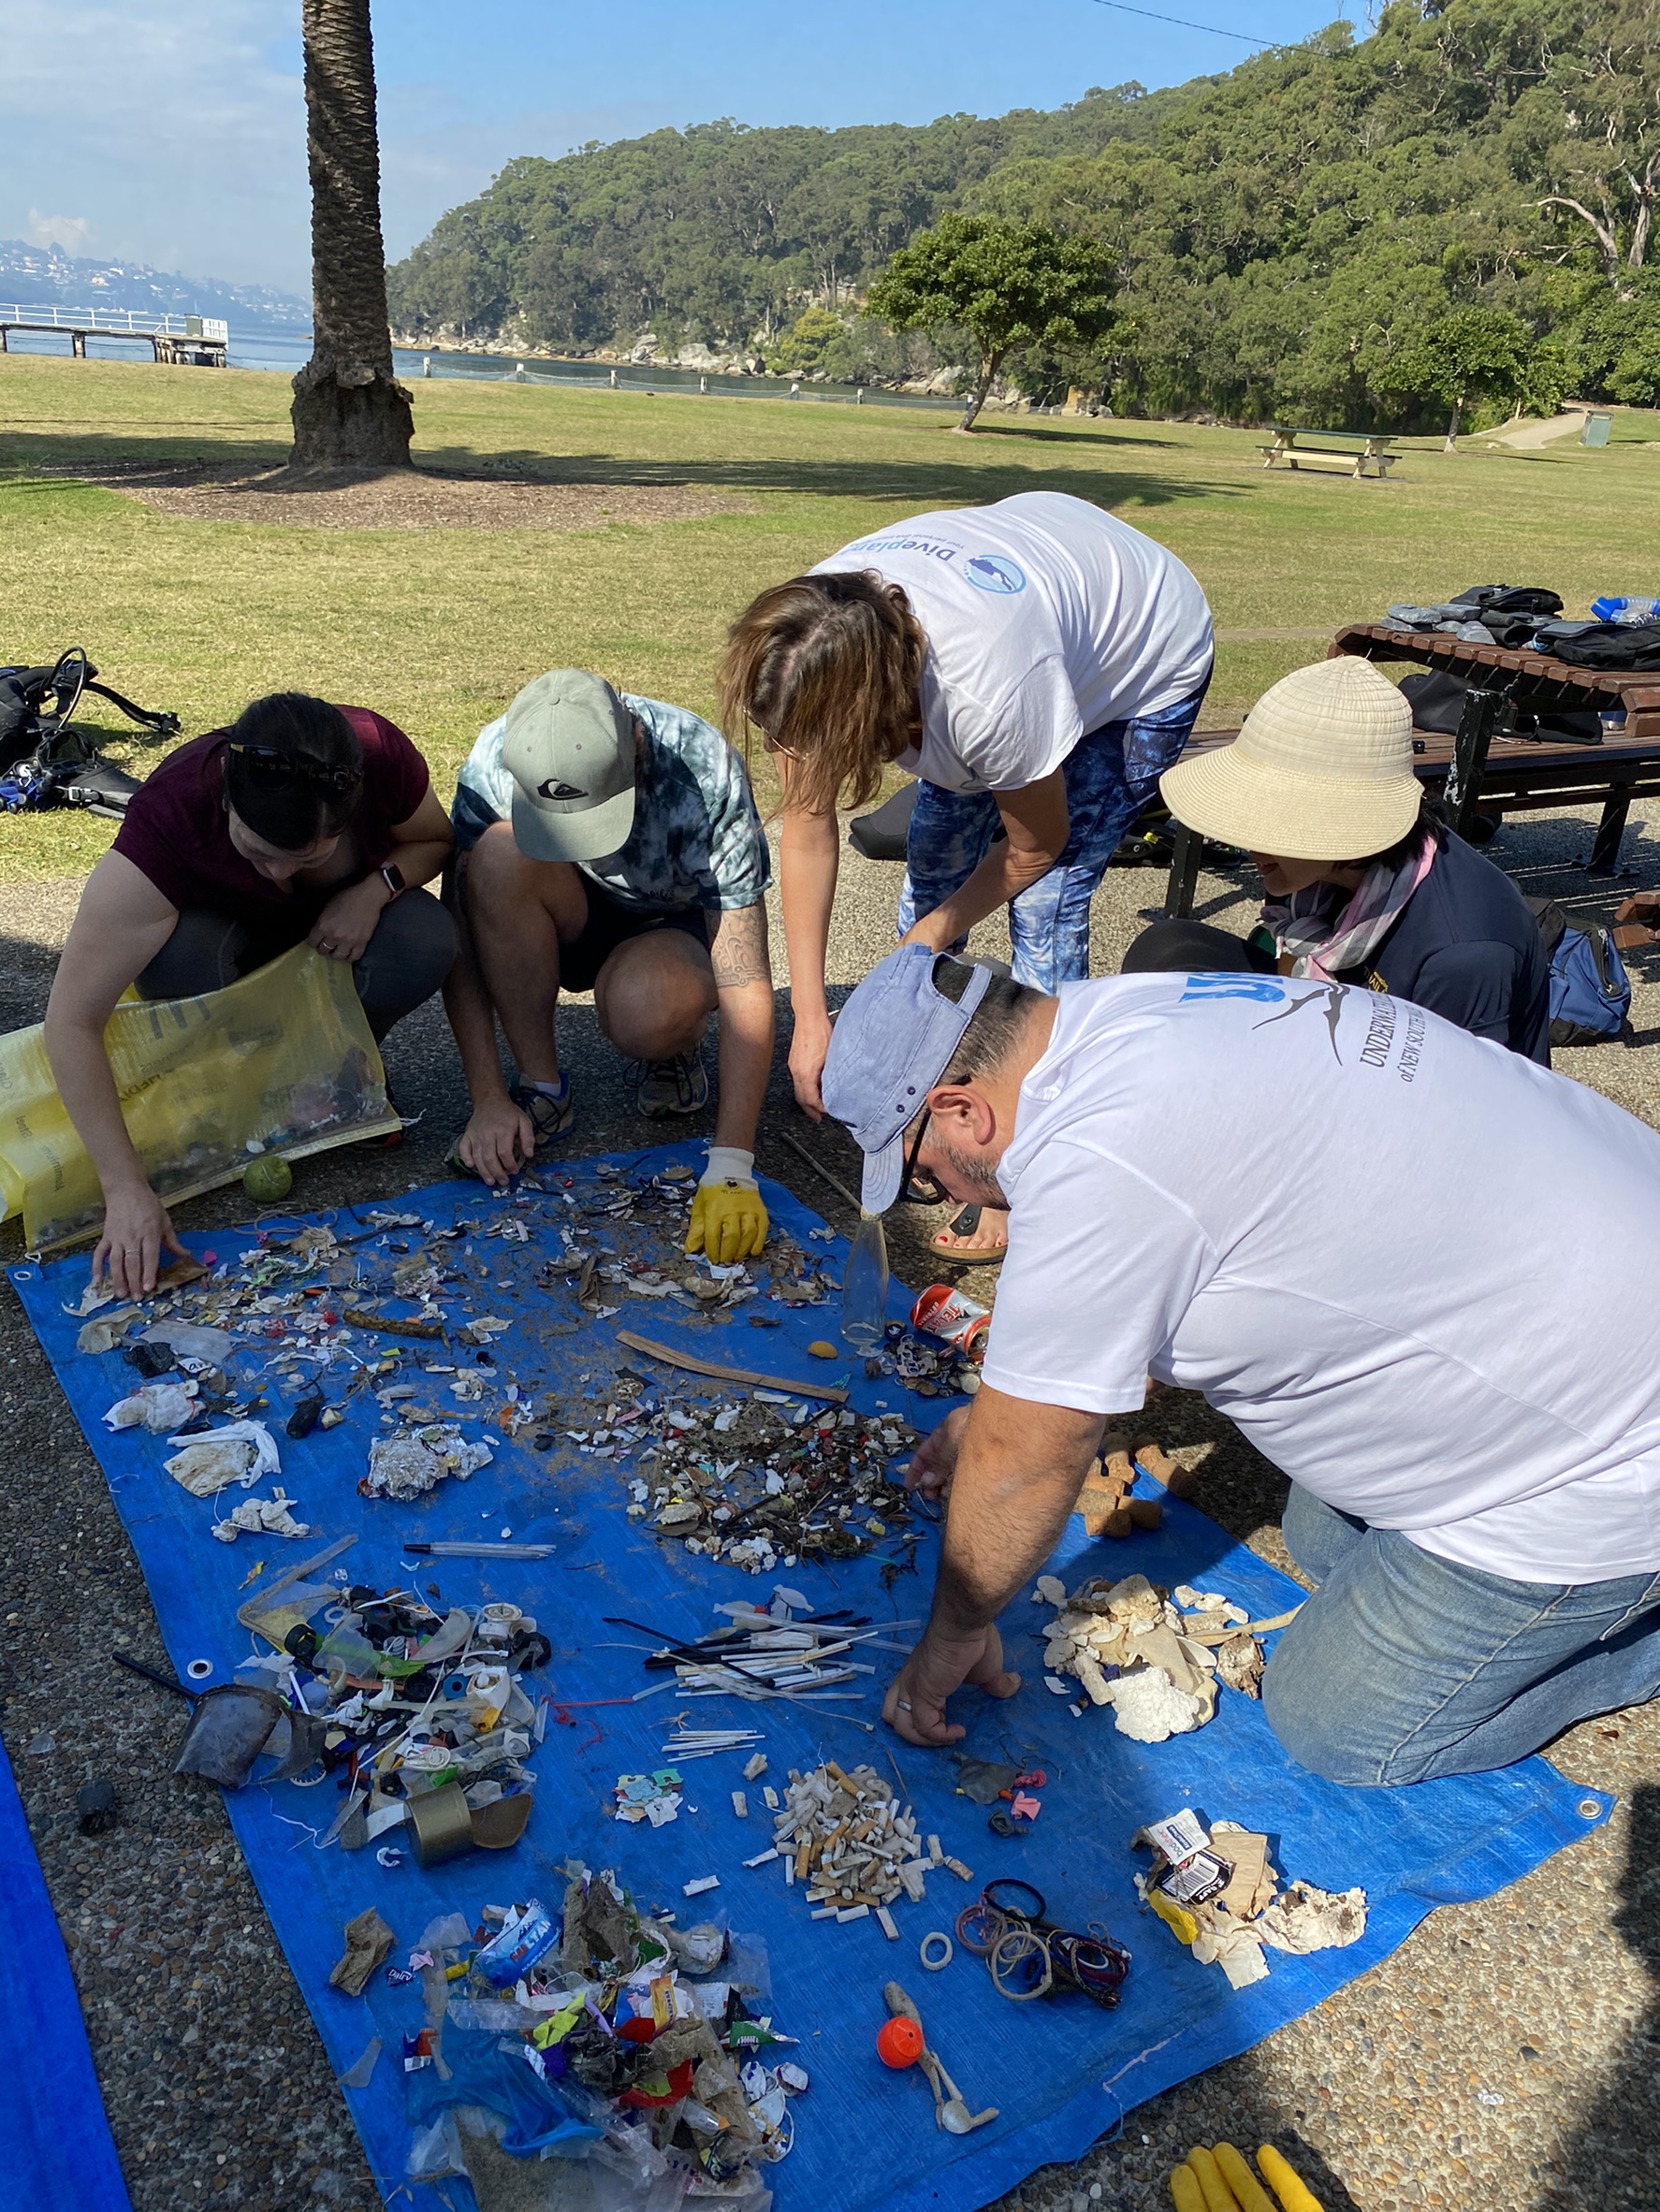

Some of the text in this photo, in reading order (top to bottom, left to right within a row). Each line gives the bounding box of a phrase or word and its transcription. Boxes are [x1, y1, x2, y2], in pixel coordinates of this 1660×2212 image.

[1406, 1014, 1426, 1046] SOUTH
[1400, 1041, 1422, 1072] NEW
[1397, 1065, 1415, 1083] of
